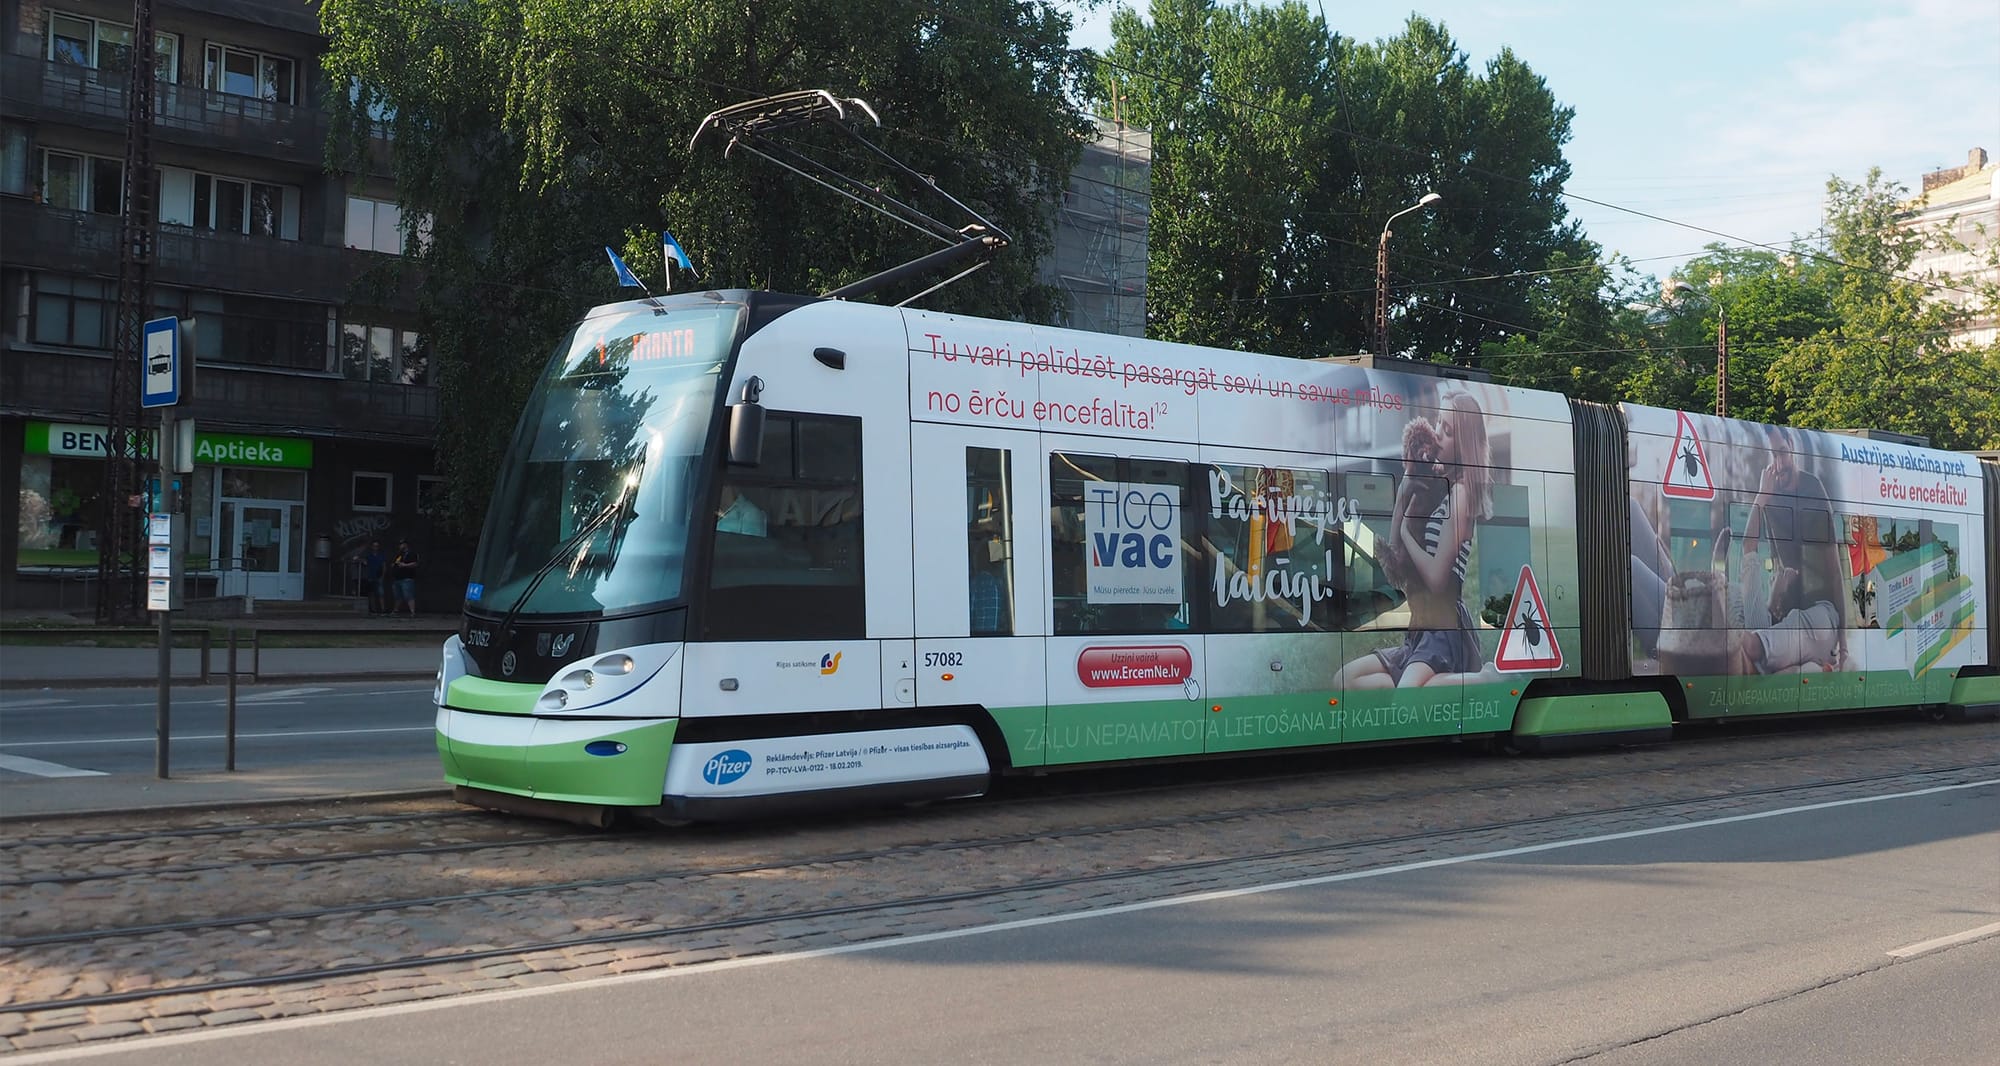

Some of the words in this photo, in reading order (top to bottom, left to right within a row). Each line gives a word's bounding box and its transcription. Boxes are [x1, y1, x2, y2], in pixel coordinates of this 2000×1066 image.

[925, 333, 957, 362] Tu
[966, 341, 1011, 368] vari
[1021, 346, 1117, 381] palīdzēt
[1123, 358, 1217, 396] pasargāt
[1224, 371, 1262, 395] sevi
[1268, 379, 1293, 399] un
[1298, 383, 1350, 405] savus
[928, 389, 960, 414] no
[968, 388, 1025, 419] ērču
[62, 431, 118, 452] BEN
[197, 440, 283, 461] Aptieka
[1841, 442, 1896, 473] Austrijas
[1897, 450, 1940, 474] vakcīna
[1945, 460, 1967, 481] pret
[1880, 477, 1906, 500] ērču
[1092, 489, 1173, 531] TICO
[1093, 532, 1173, 568] vac
[925, 652, 962, 667] 57082
[1091, 664, 1180, 680] www.ErcemNe.lv
[1024, 723, 1079, 753] ZĀĻU
[1086, 719, 1219, 747] NEPAMATOTA
[1225, 708, 1326, 738] LIETOŠANA
[1329, 710, 1347, 730] IR
[1352, 703, 1419, 727] KAITĪGA
[766, 763, 824, 774] PP-TCV-LVA-0122
[815, 751, 835, 759] Pfizer
[836, 749, 858, 758] Latvija
[706, 755, 750, 785] Pfizer
